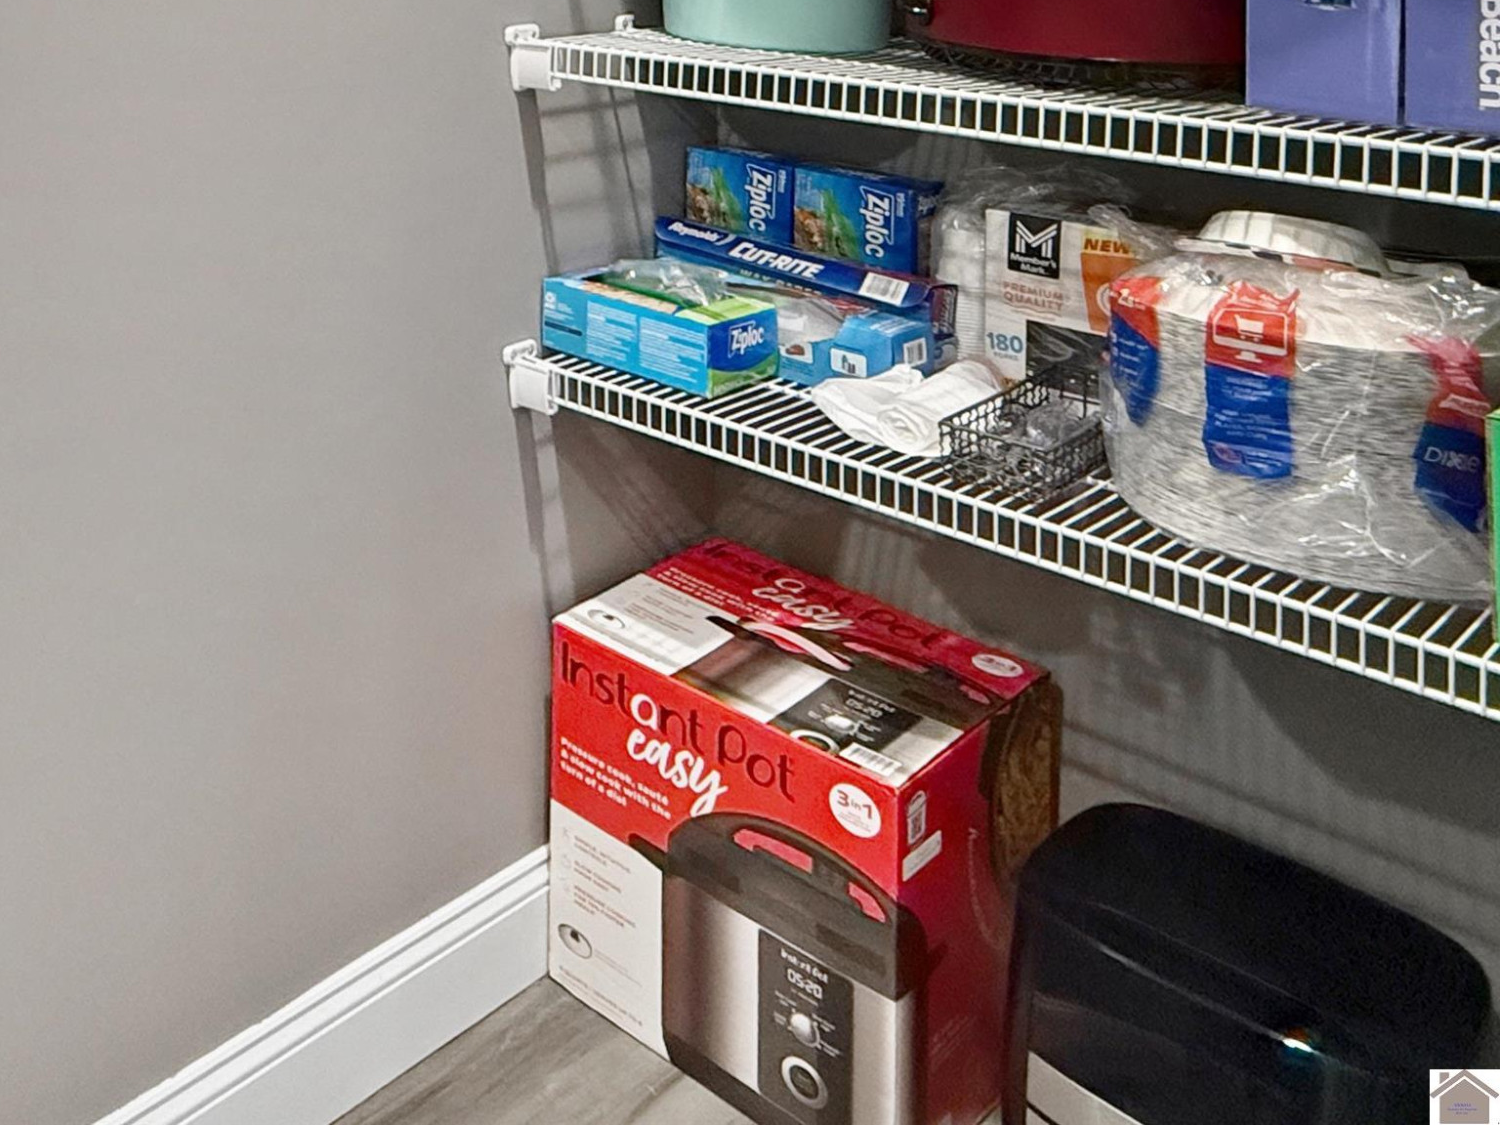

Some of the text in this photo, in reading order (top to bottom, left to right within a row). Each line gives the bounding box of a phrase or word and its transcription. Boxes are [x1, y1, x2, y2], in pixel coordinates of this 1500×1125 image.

[749, 169, 772, 232] Ziploc
[864, 192, 890, 259] Ziploc
[668, 222, 825, 279] Reynolds CUT-RITE
[1009, 252, 1057, 269] Member's
[1083, 237, 1131, 255] NEW
[1003, 281, 1064, 301] PREMIUM
[1003, 291, 1064, 311] QUALITY
[731, 326, 766, 356] Ziploc
[986, 331, 1023, 354] 180
[560, 640, 797, 804] Instant Pot
[560, 736, 606, 769] Pressure
[560, 759, 584, 781] turn
[584, 776, 597, 788] of
[597, 784, 605, 793] a
[569, 755, 595, 776] slow
[595, 770, 621, 792] cook
[622, 786, 650, 808] with
[650, 801, 672, 821] the
[626, 728, 729, 819] easy
